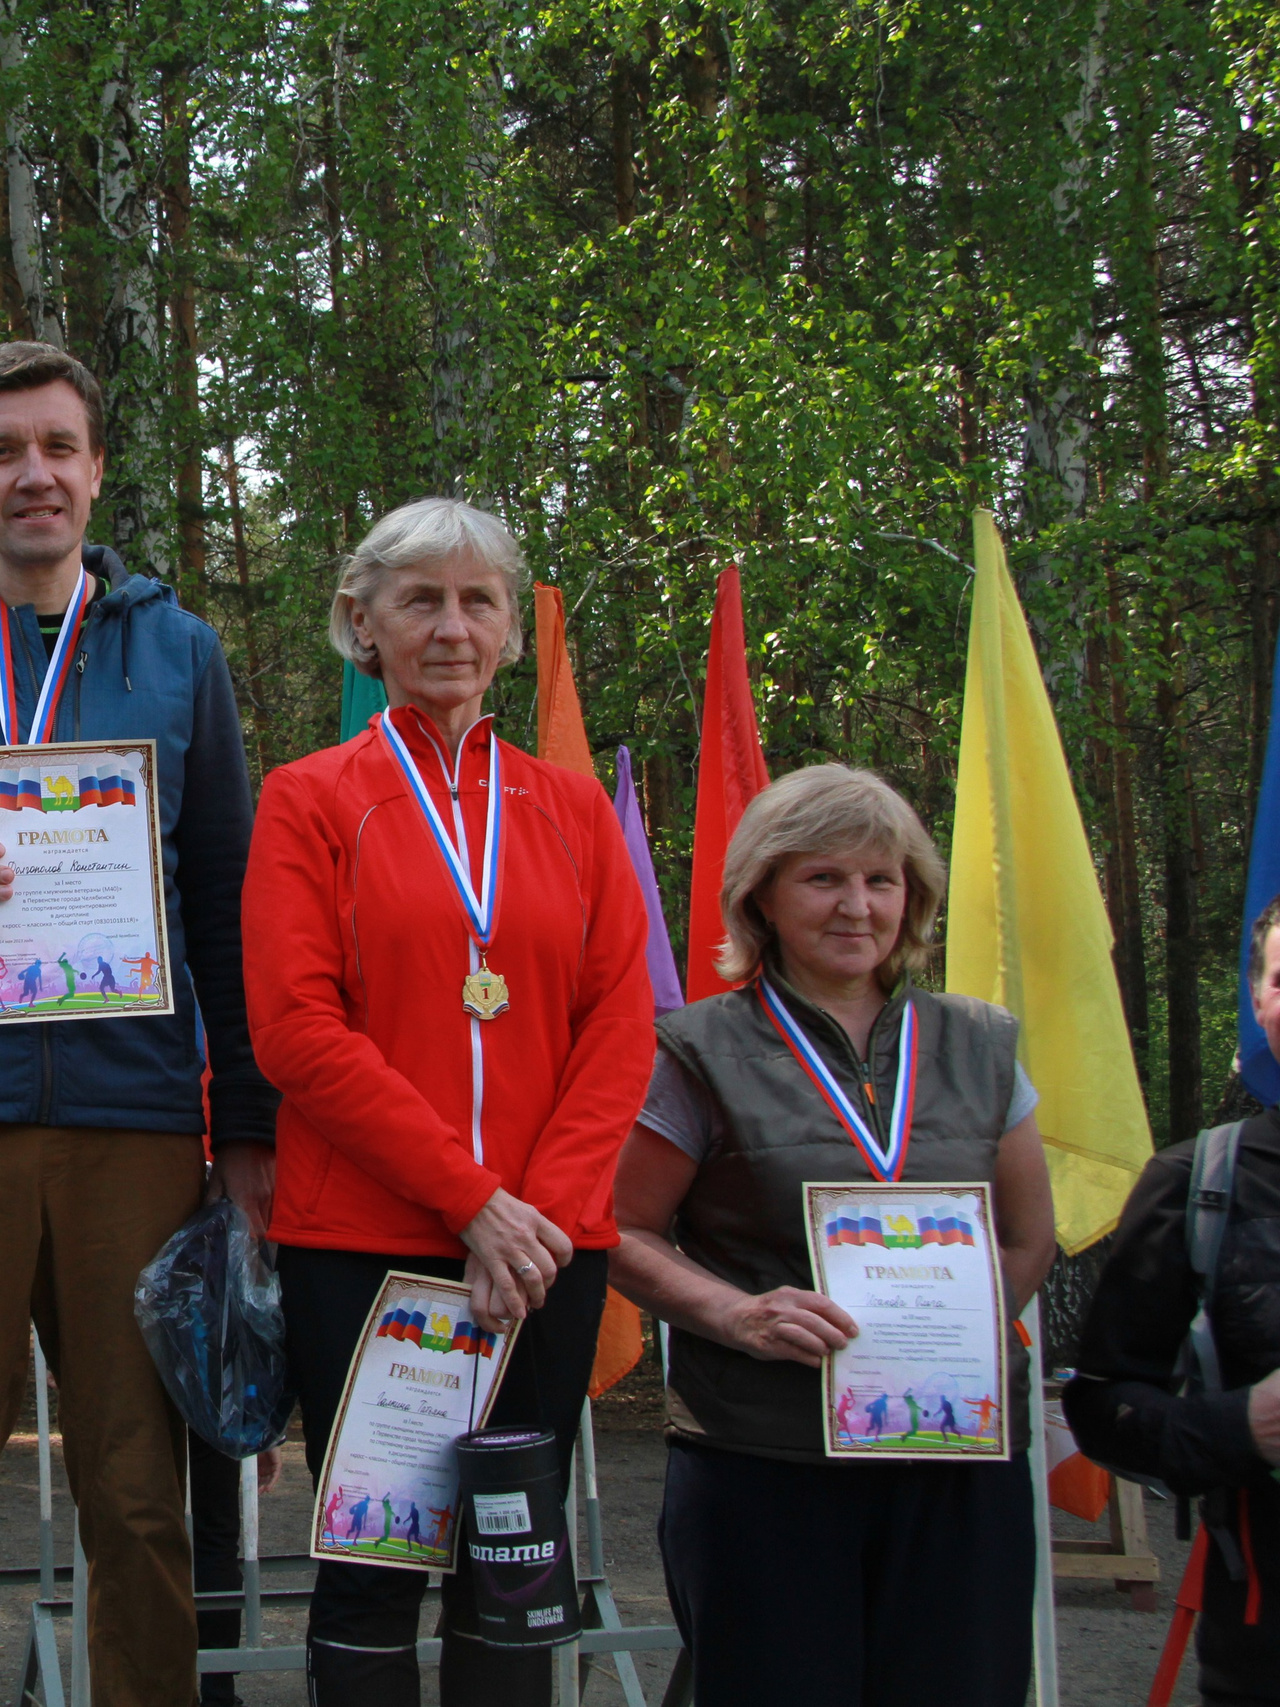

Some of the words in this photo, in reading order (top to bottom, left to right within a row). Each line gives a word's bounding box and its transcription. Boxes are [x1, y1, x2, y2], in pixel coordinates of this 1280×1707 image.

[478, 779, 517, 795] CFT
[17, 827, 108, 845] ГРАМОТА
[26, 896, 59, 904] Первенстве
[81, 893, 115, 901] Челябинска
[30, 904, 67, 912] спортивному
[68, 902, 117, 910] ориентированию
[54, 911, 89, 919] дисциплине
[481, 988, 489, 999] 1
[864, 1266, 954, 1280] ГРАМОТА
[389, 1363, 460, 1389] ГРАМОТА
[468, 1540, 555, 1563] oname
[526, 1608, 551, 1621] SKINLIFE
[552, 1605, 564, 1615] PRO
[527, 1614, 564, 1628] UNDERWEAR
